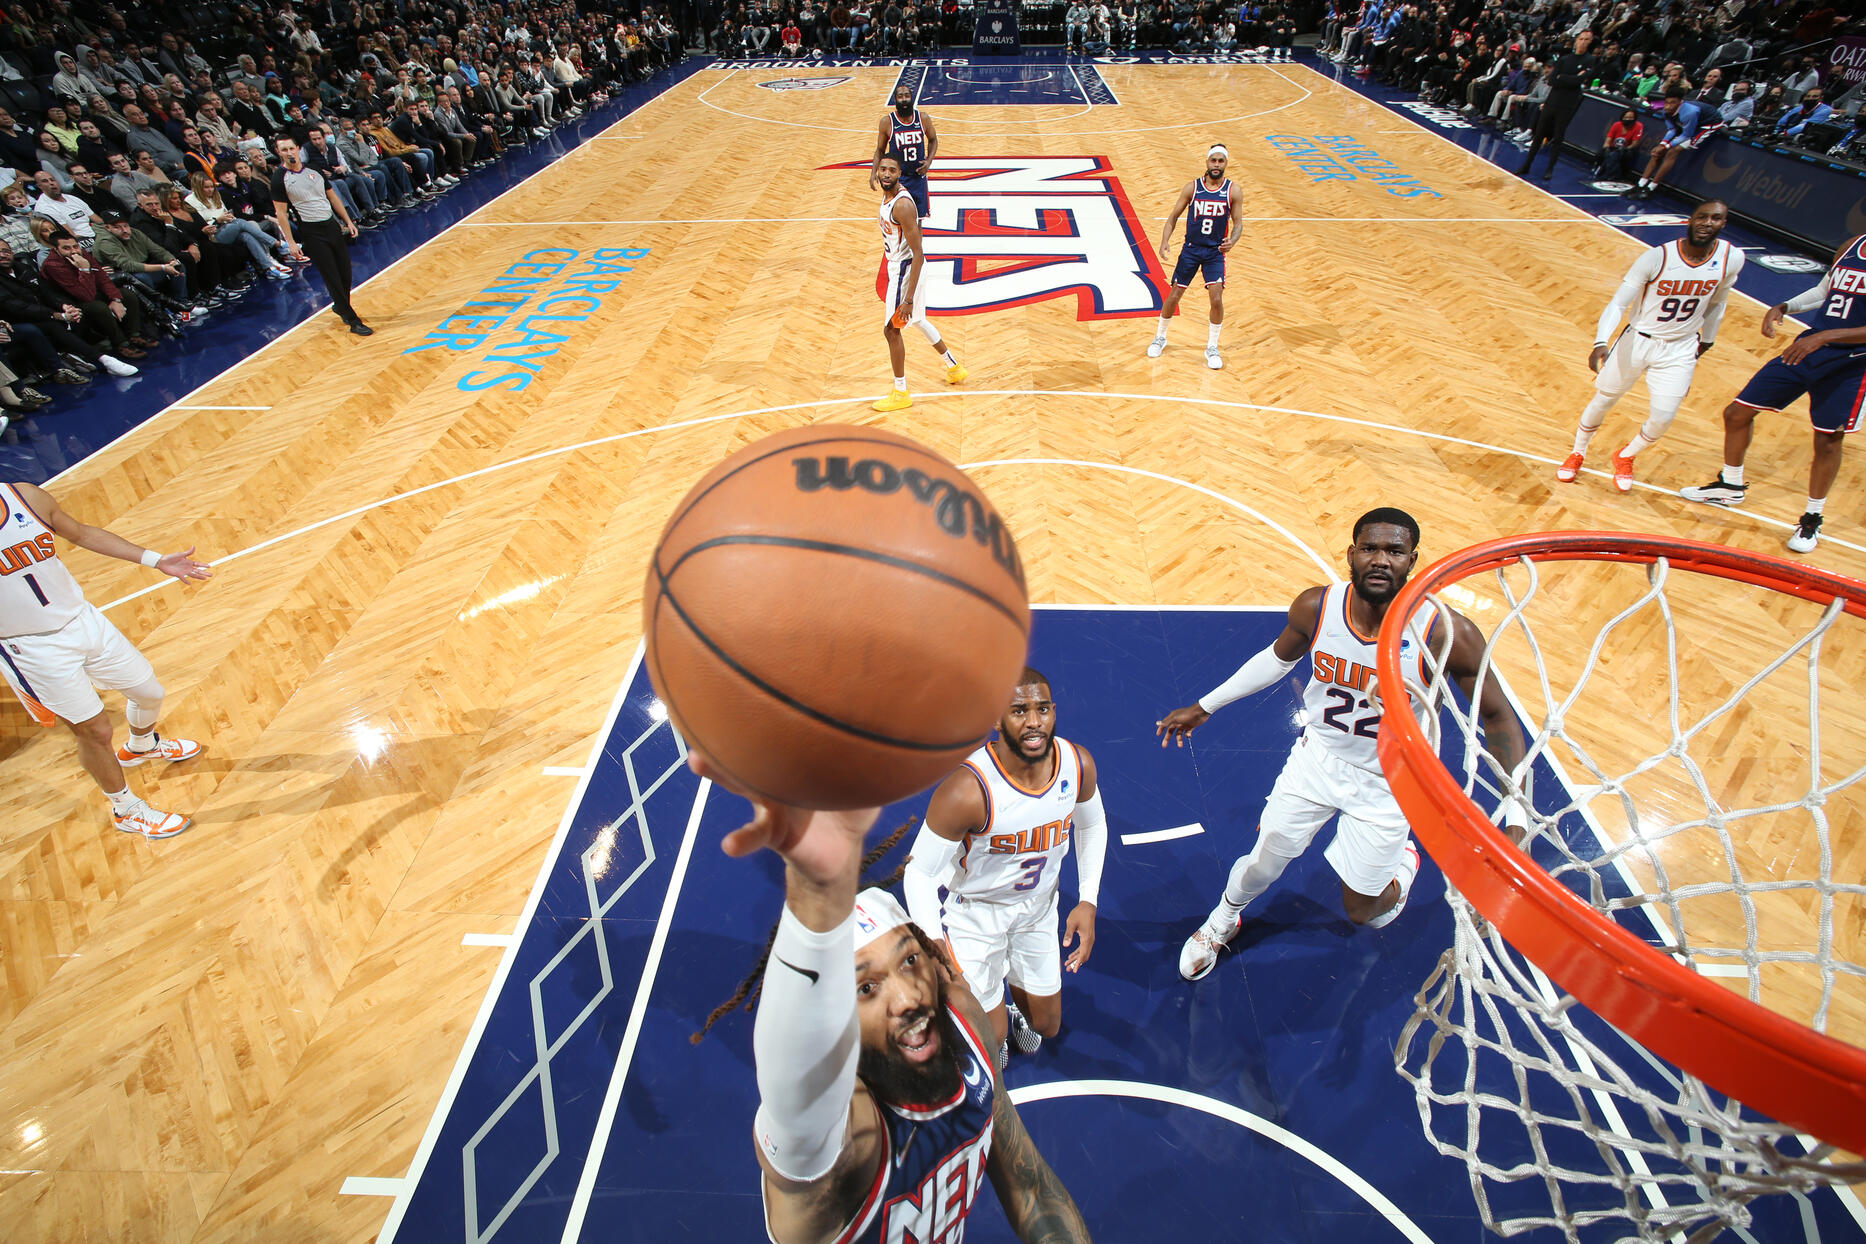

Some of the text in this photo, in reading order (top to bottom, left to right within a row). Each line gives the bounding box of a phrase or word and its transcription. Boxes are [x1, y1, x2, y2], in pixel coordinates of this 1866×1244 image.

[979, 36, 1014, 44] BARCLAYS
[1830, 44, 1866, 68] QAT
[704, 58, 969, 70] BROOKLYN NETS
[895, 131, 922, 150] NETS
[903, 147, 917, 162] 13
[1264, 135, 1358, 183] CENTER
[1312, 135, 1443, 198] BARCLAYS
[1736, 163, 1813, 209] Webull
[1194, 200, 1228, 219] NETS
[1201, 218, 1214, 235] 8
[815, 155, 1180, 321] NETS
[400, 247, 580, 355] CENTER
[1656, 297, 1701, 322] 99
[1825, 293, 1854, 319] 21
[456, 247, 653, 392] BARCLAYS
[0, 531, 56, 577] UNS
[22, 573, 50, 608] 1
[1314, 650, 1381, 694] SUN
[1323, 687, 1379, 739] 22
[1014, 856, 1048, 891] 3
